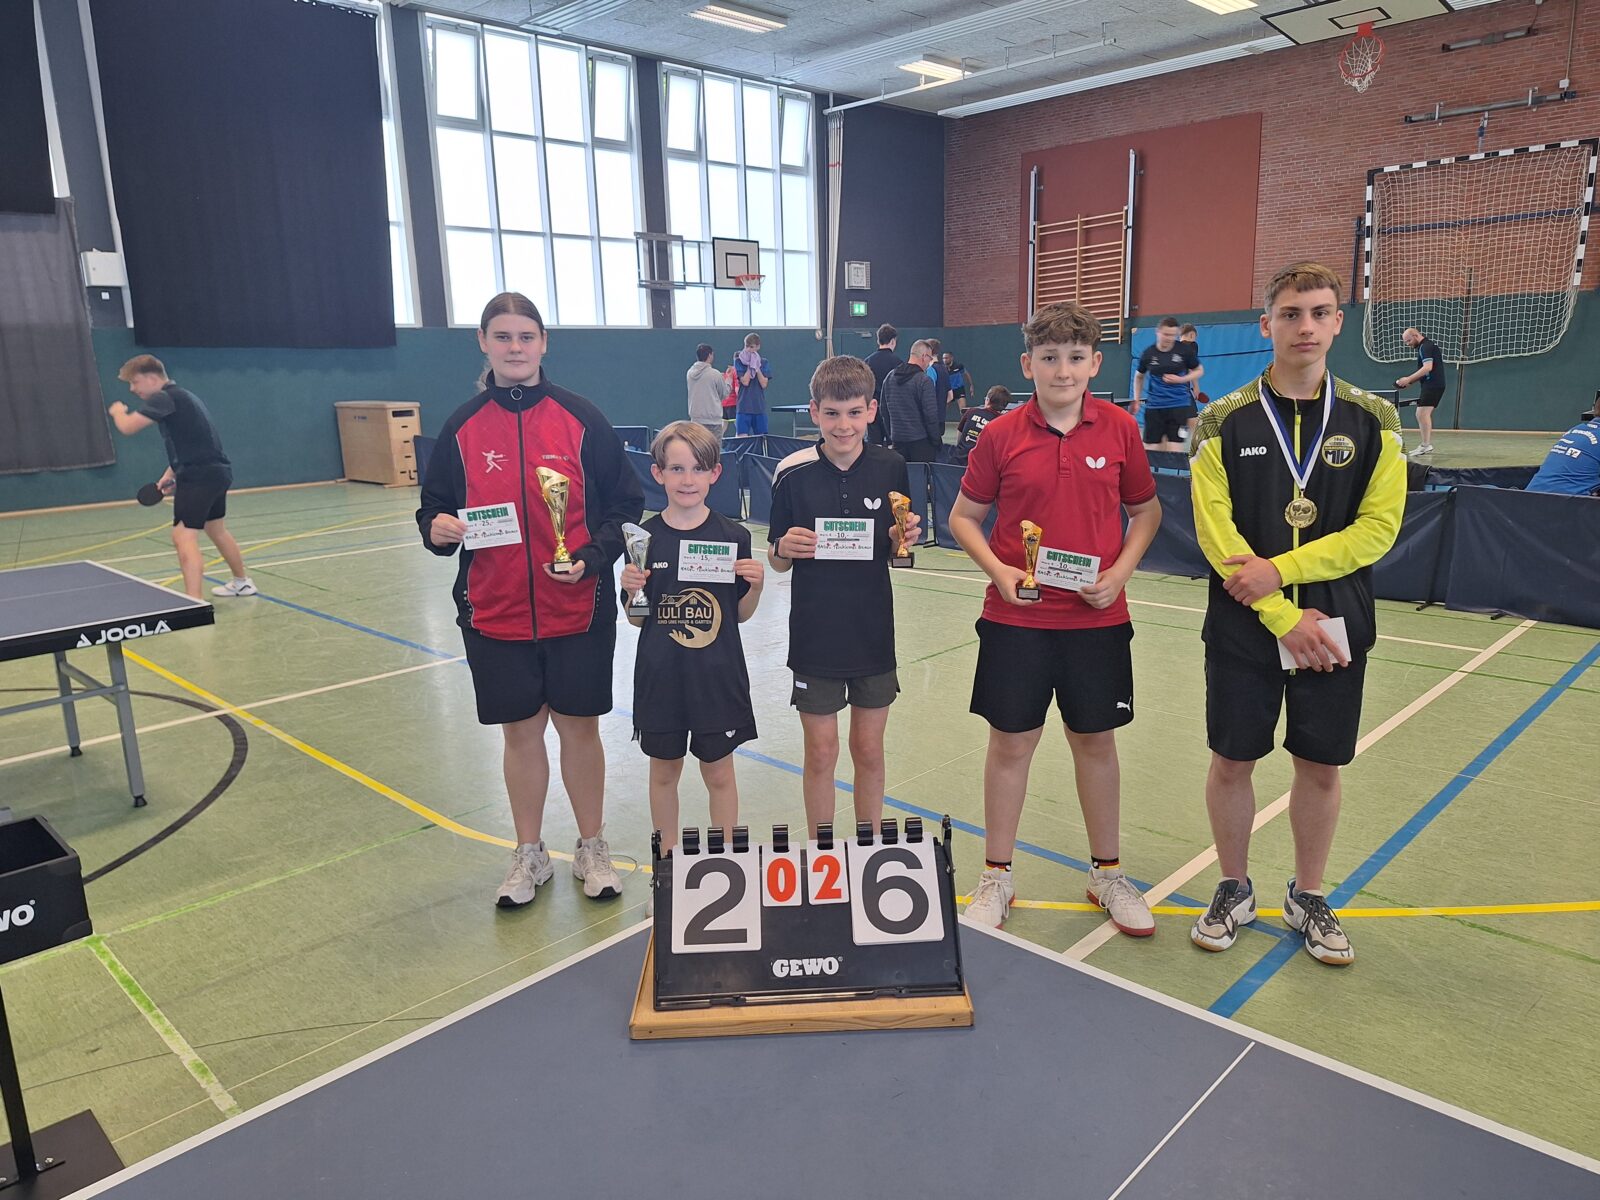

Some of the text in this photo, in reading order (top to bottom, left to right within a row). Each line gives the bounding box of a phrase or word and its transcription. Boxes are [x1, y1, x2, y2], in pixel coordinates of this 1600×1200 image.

[1240, 446, 1268, 457] JAKO
[467, 506, 509, 521] GUTSCHEIN
[824, 521, 867, 532] GUTSCHEIN
[688, 544, 730, 556] GUTSCHEIN
[1046, 550, 1092, 568] GUTSCHEIN
[657, 607, 712, 619] LULI BAU
[95, 620, 172, 645] JOOLA
[684, 847, 930, 945] 2 0 2 6
[0, 904, 35, 932] WO
[772, 957, 840, 978] GEWO
